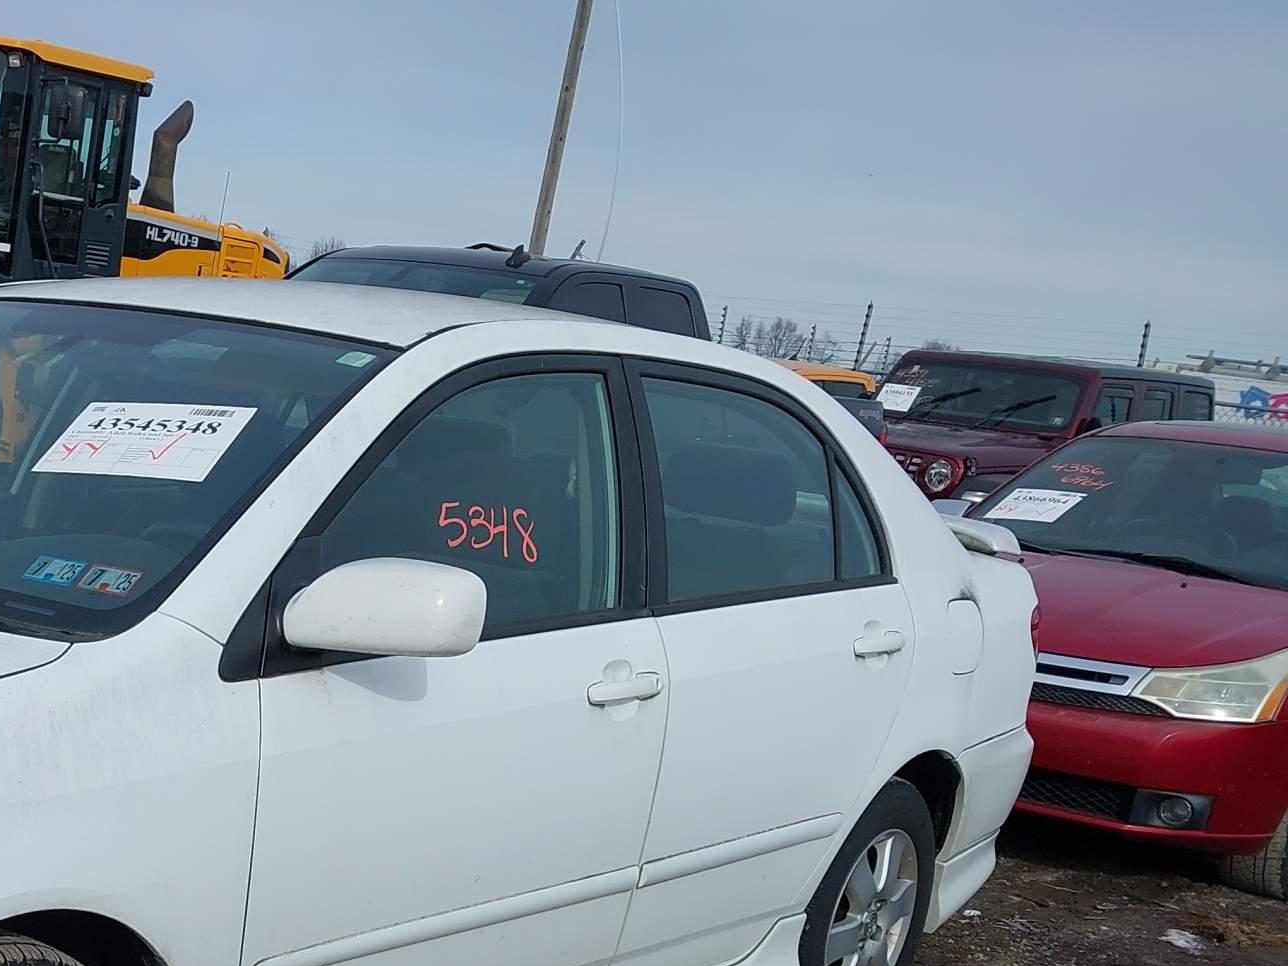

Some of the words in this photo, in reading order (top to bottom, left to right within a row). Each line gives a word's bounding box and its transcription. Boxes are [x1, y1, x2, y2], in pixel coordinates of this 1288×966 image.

[145, 226, 199, 247] HL740-9
[87, 416, 223, 435] 43545348
[439, 501, 538, 563] 5348
